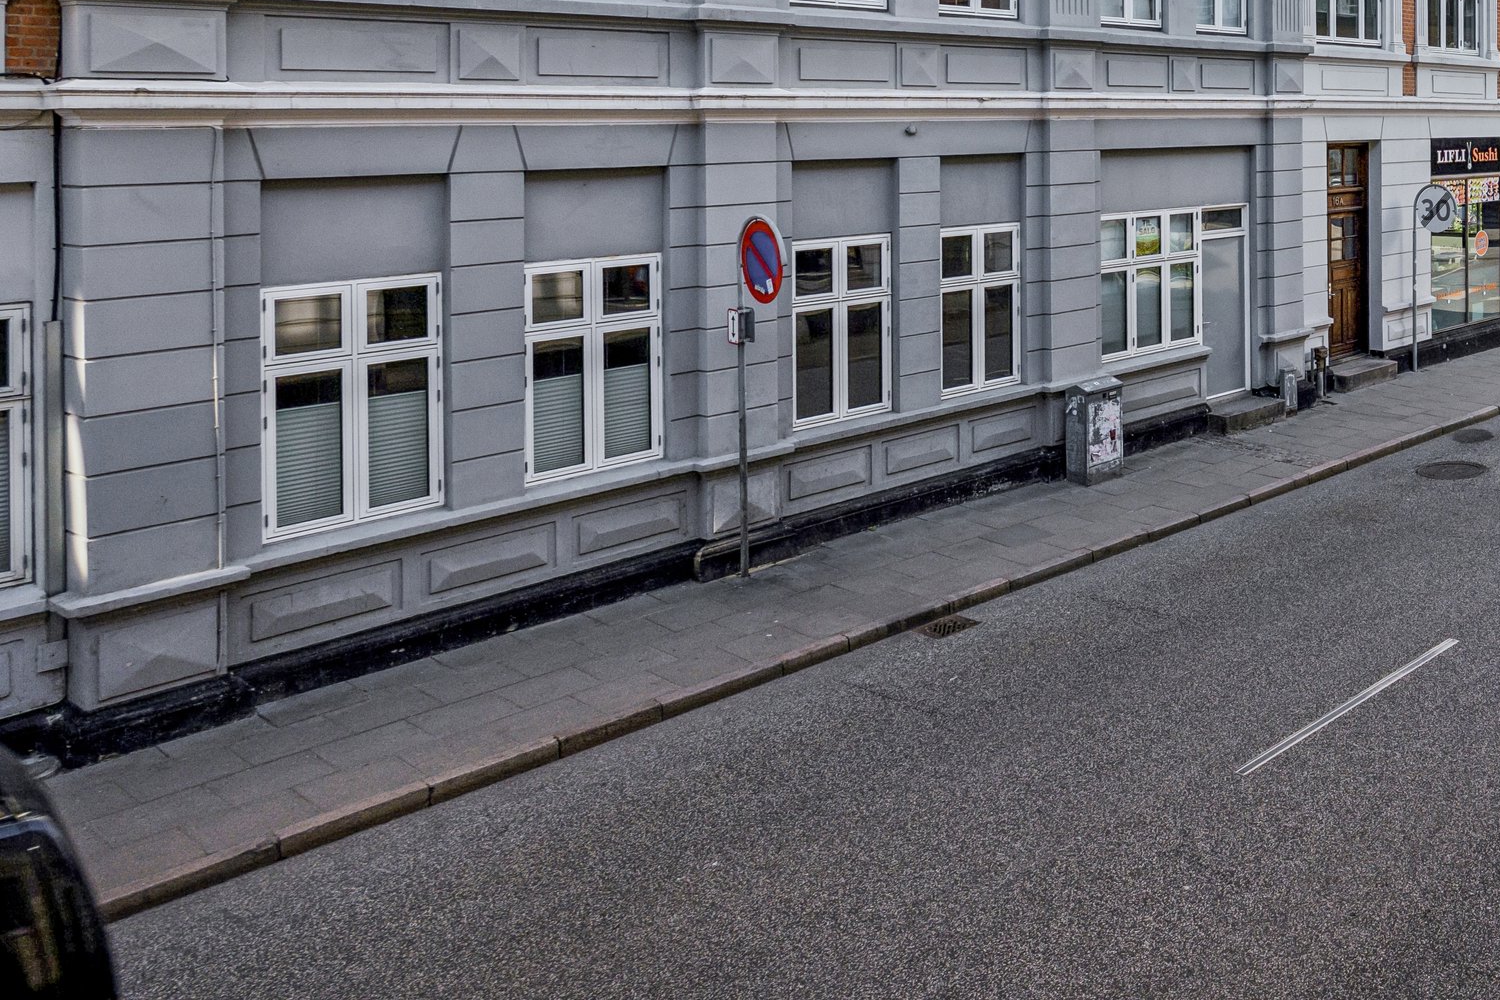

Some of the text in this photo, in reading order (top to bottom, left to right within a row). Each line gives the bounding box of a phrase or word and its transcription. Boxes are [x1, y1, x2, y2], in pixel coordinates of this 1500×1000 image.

[1437, 147, 1498, 164] LIFLI Sushi
[1421, 198, 1450, 222] 30
